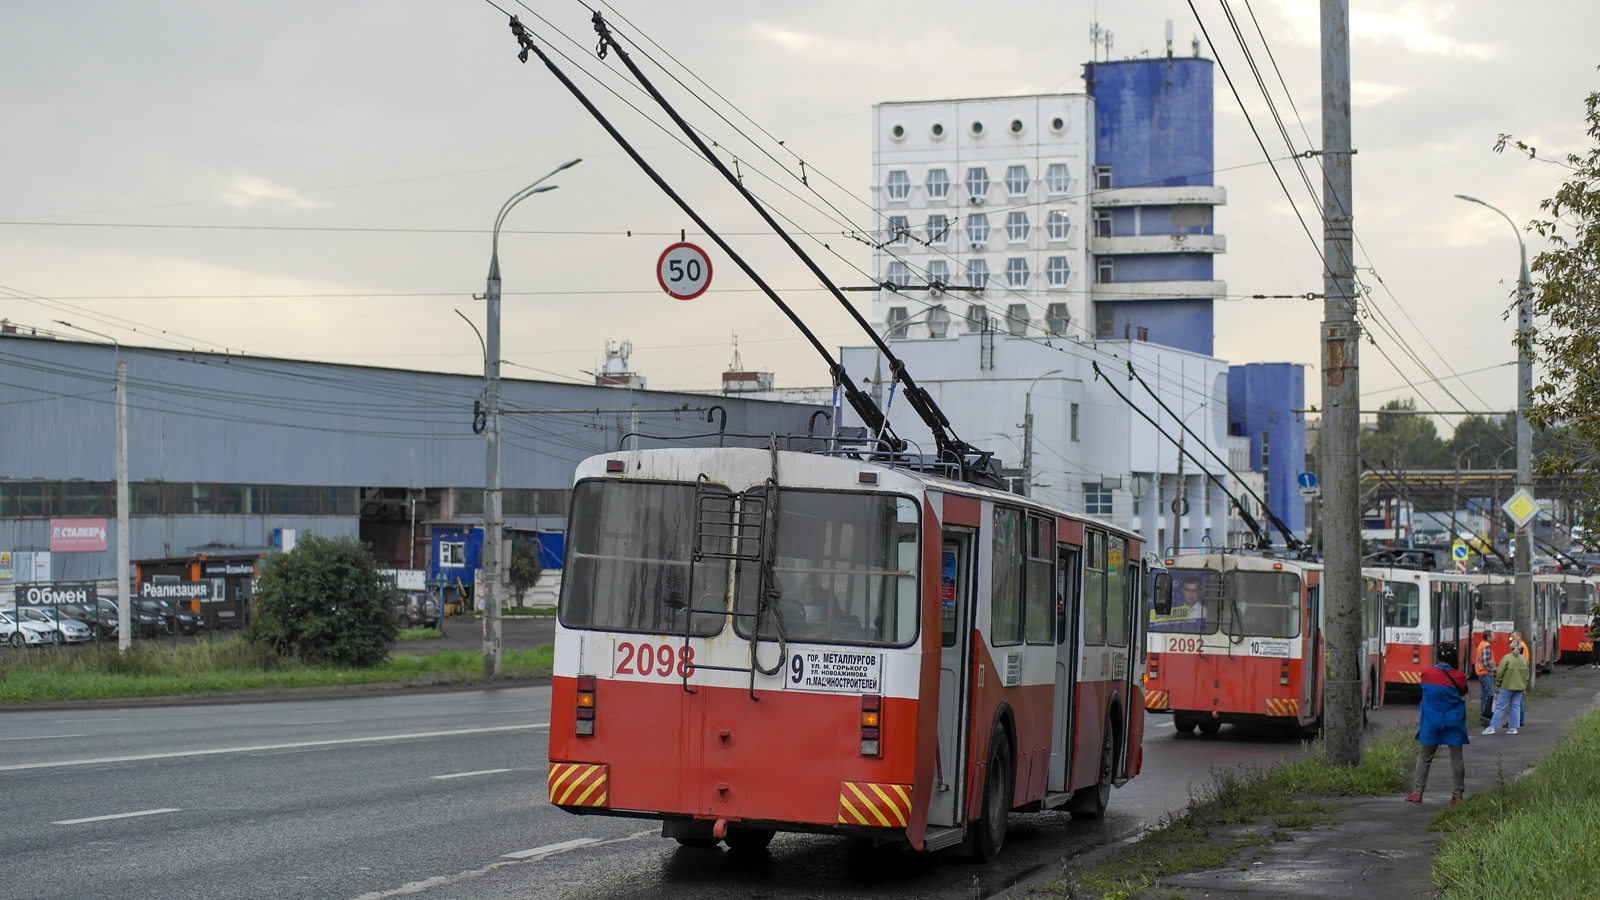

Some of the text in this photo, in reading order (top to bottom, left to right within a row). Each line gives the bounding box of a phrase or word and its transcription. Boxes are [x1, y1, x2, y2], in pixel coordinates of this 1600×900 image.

[669, 259, 701, 282] 50
[61, 527, 100, 538] СТАЛКЕР
[27, 587, 87, 605] Обмен
[143, 583, 207, 598] Реализация
[1396, 633, 1400, 642] 9
[1169, 638, 1204, 653] 2092
[1251, 641, 1259, 654] 10
[615, 642, 695, 678] 2098
[807, 653, 876, 666] ГОР. МЕТАЛЛУРГОВ
[791, 654, 804, 684] 9
